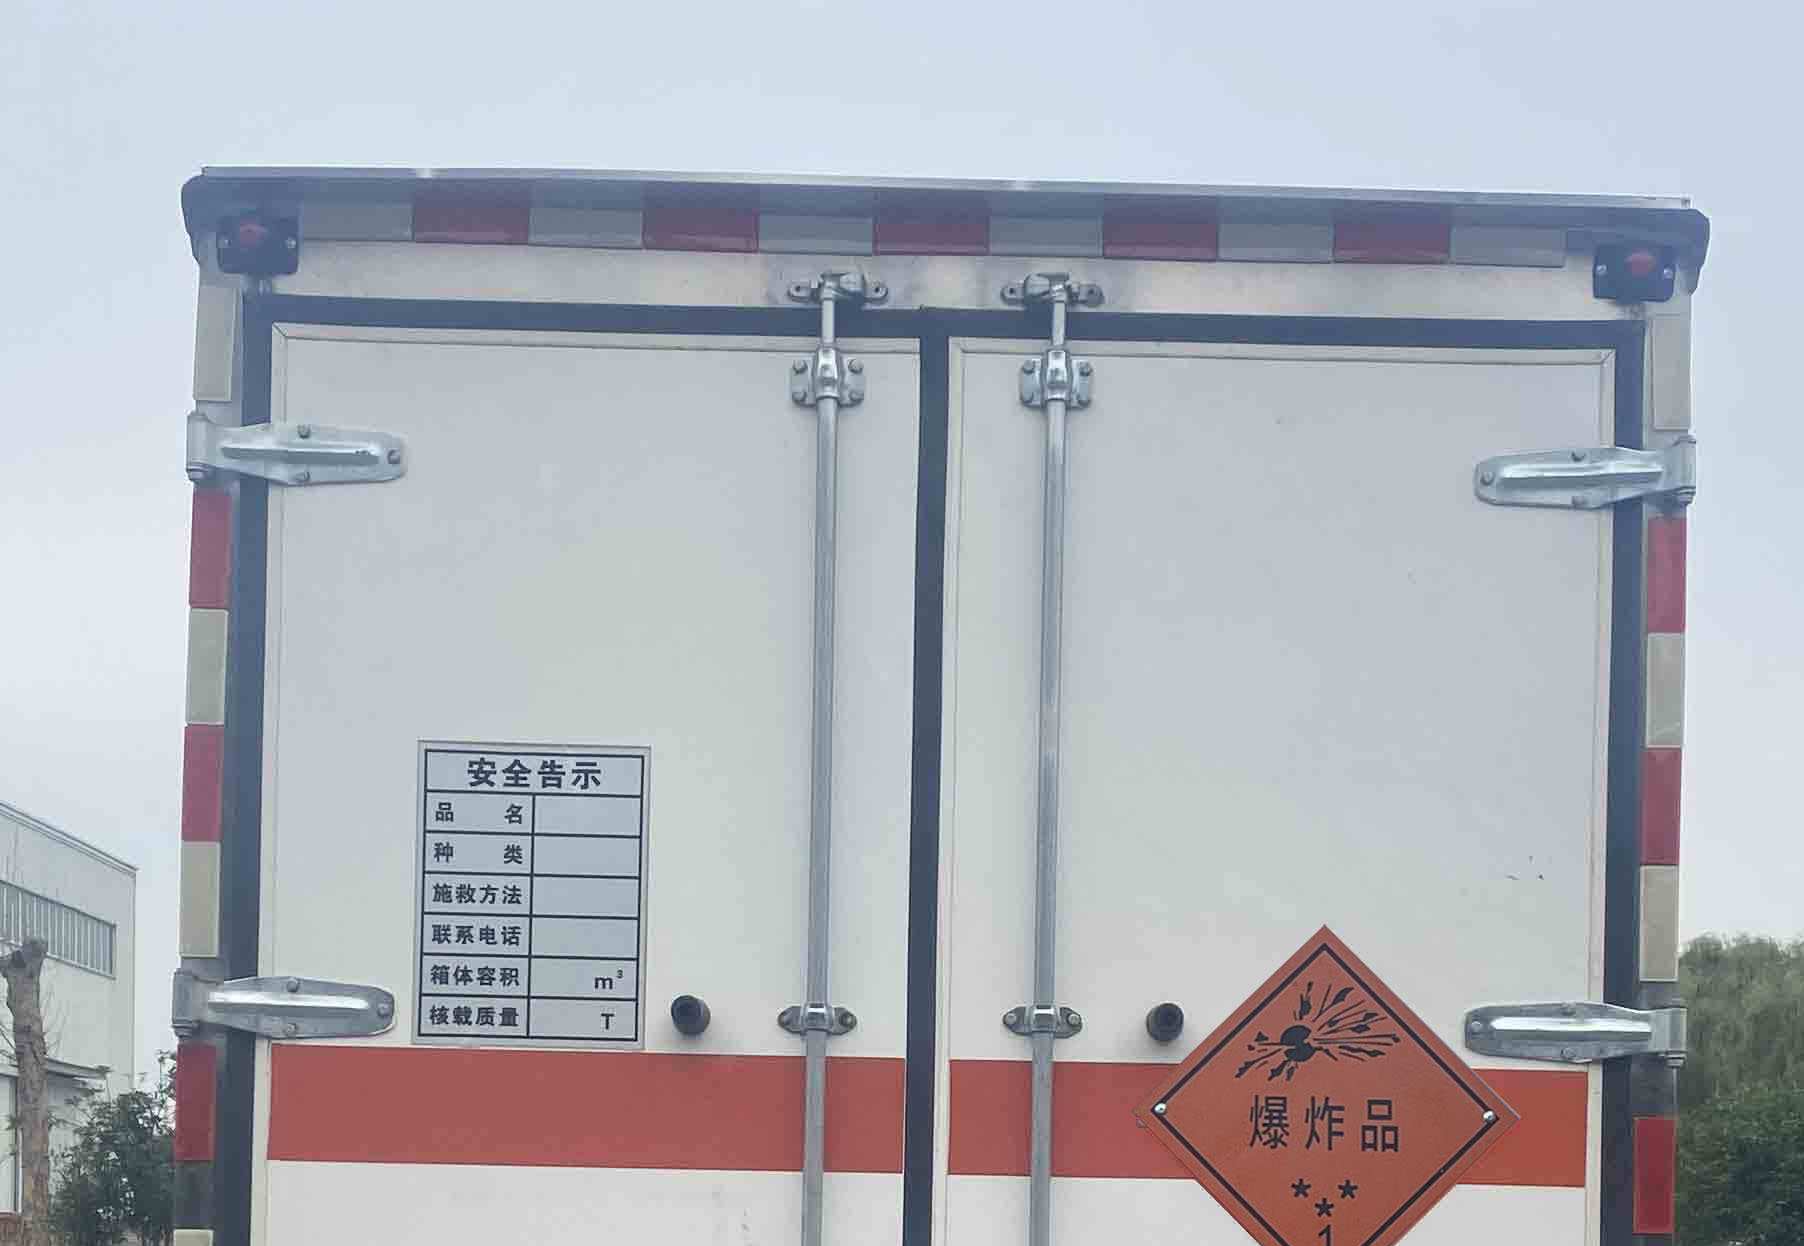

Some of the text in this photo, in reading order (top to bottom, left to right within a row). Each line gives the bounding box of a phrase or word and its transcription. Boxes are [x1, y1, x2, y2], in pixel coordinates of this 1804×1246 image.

[467, 757, 601, 790] 安全告示
[434, 802, 523, 824] 品名
[433, 842, 523, 864] 种类
[432, 883, 522, 904] 施救方法
[431, 924, 521, 946] 联系电话
[430, 965, 520, 986] 箱体容积
[429, 1005, 519, 1027] 核载质量
[600, 1013, 615, 1030] T
[1249, 1095, 1399, 1152] 爆炸品
